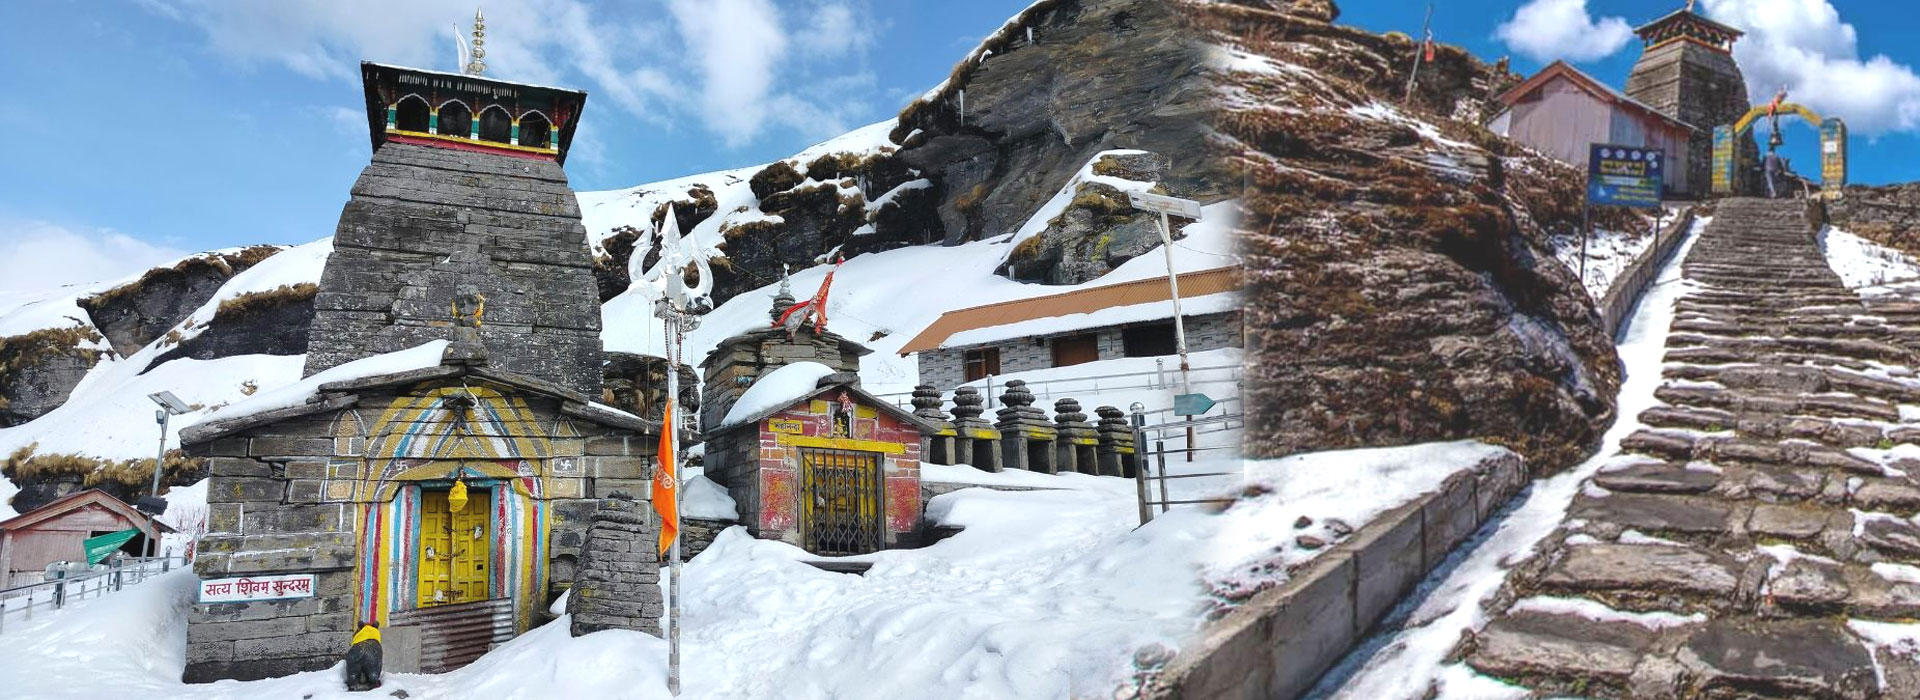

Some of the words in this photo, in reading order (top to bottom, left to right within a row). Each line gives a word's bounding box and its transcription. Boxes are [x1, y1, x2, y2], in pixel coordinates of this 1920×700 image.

[205, 583, 232, 596] सत्य
[236, 578, 270, 595] शिवम्
[272, 578, 311, 596] सुन्दरम्
